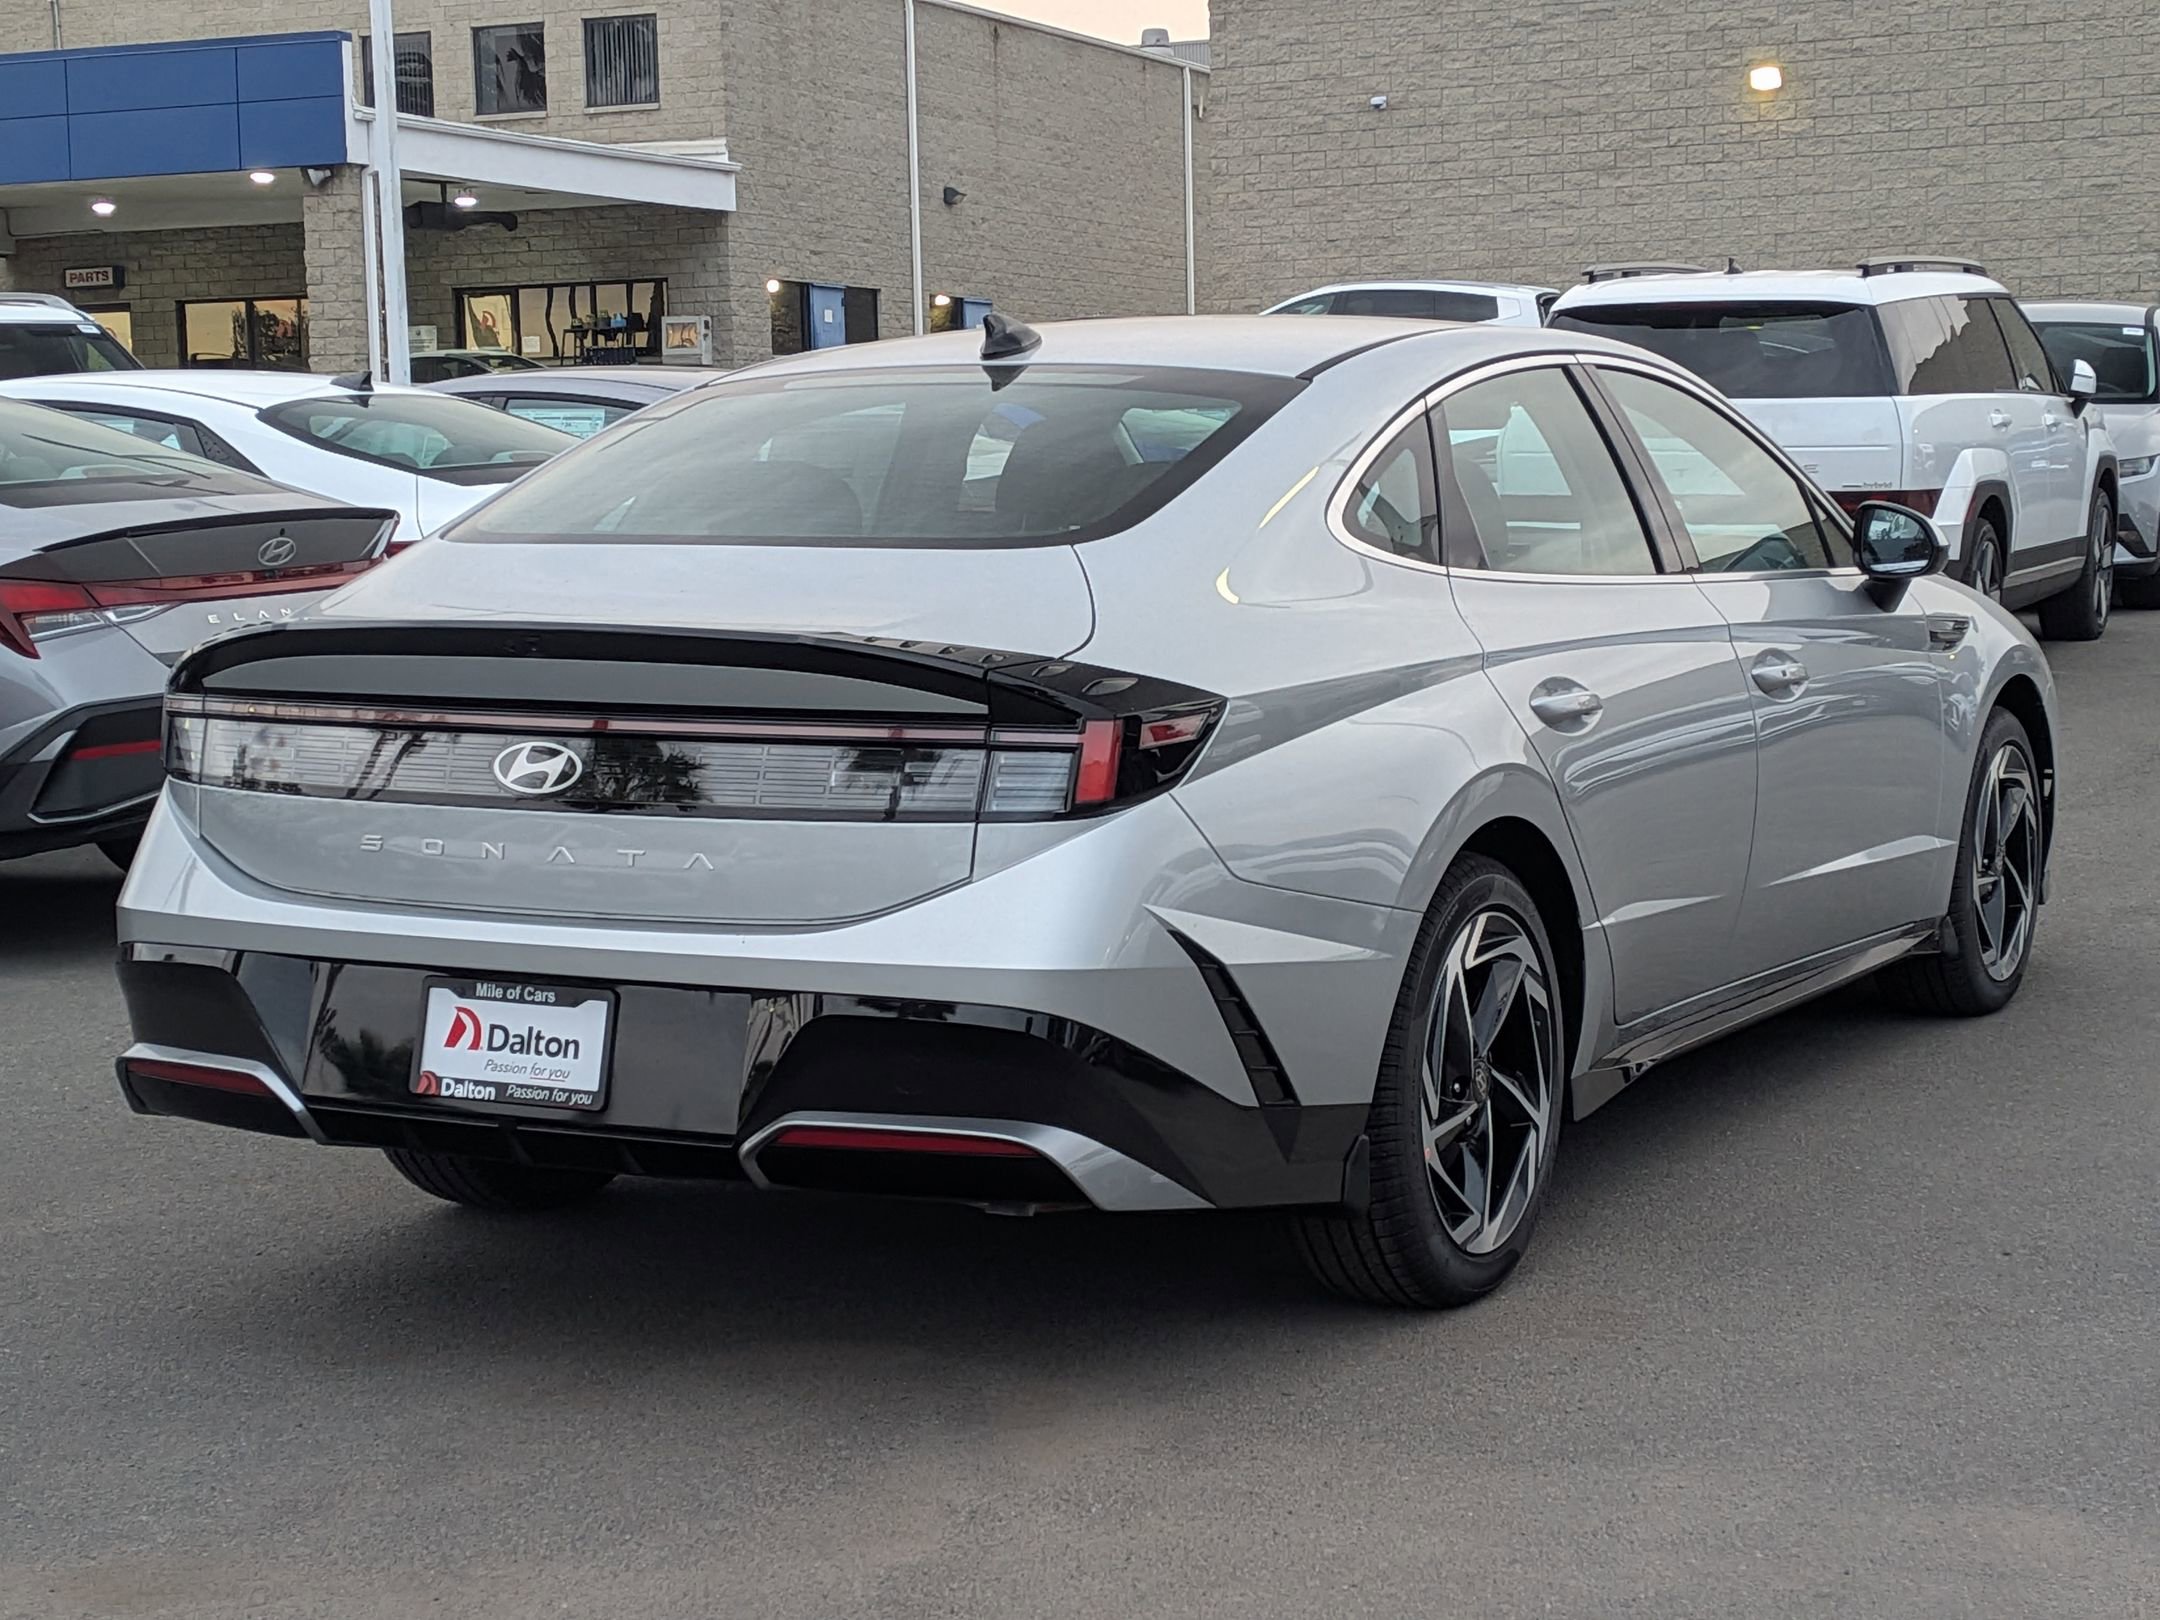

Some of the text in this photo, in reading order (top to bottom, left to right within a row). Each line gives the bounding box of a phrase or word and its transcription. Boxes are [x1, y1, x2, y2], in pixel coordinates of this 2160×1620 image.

[69, 270, 109, 284] PARTS
[207, 607, 309, 624] ELAN
[359, 833, 715, 871] SONATA
[475, 982, 556, 1003] Mile of Cars
[486, 1023, 580, 1060] Dalton
[484, 1059, 571, 1081] Passion for you
[440, 1078, 496, 1101] Dalton
[506, 1085, 593, 1106] Passion for you
